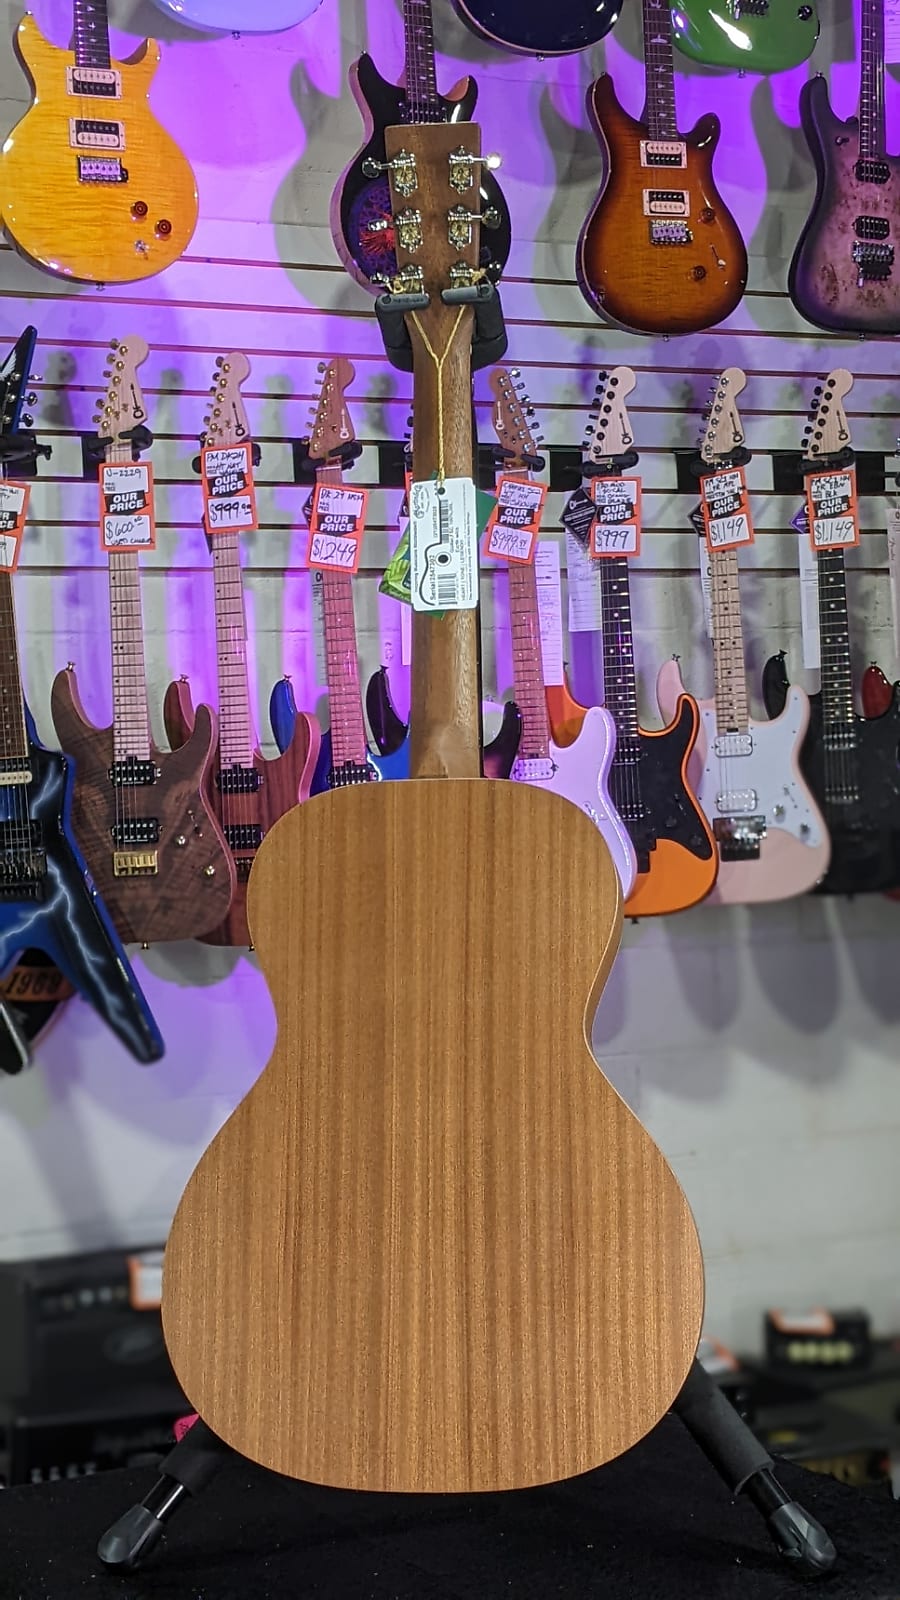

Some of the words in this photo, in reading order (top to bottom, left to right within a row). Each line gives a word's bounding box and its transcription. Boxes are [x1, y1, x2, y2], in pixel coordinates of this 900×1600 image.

[215, 474, 238, 486] OUR
[212, 480, 244, 496] PRICE
[113, 493, 138, 503] OUR
[714, 496, 734, 508] OUR
[820, 498, 842, 508] OUR
[110, 500, 144, 512] PRICE
[604, 505, 626, 514] OUR
[712, 501, 740, 518] PRICE
[818, 503, 848, 517] PRICE
[500, 516, 532, 524] PRICE
[600, 511, 632, 522] PRICE
[320, 523, 354, 532] PRICE
[711, 517, 744, 543] $1,149
[313, 539, 357, 562] $1,249
